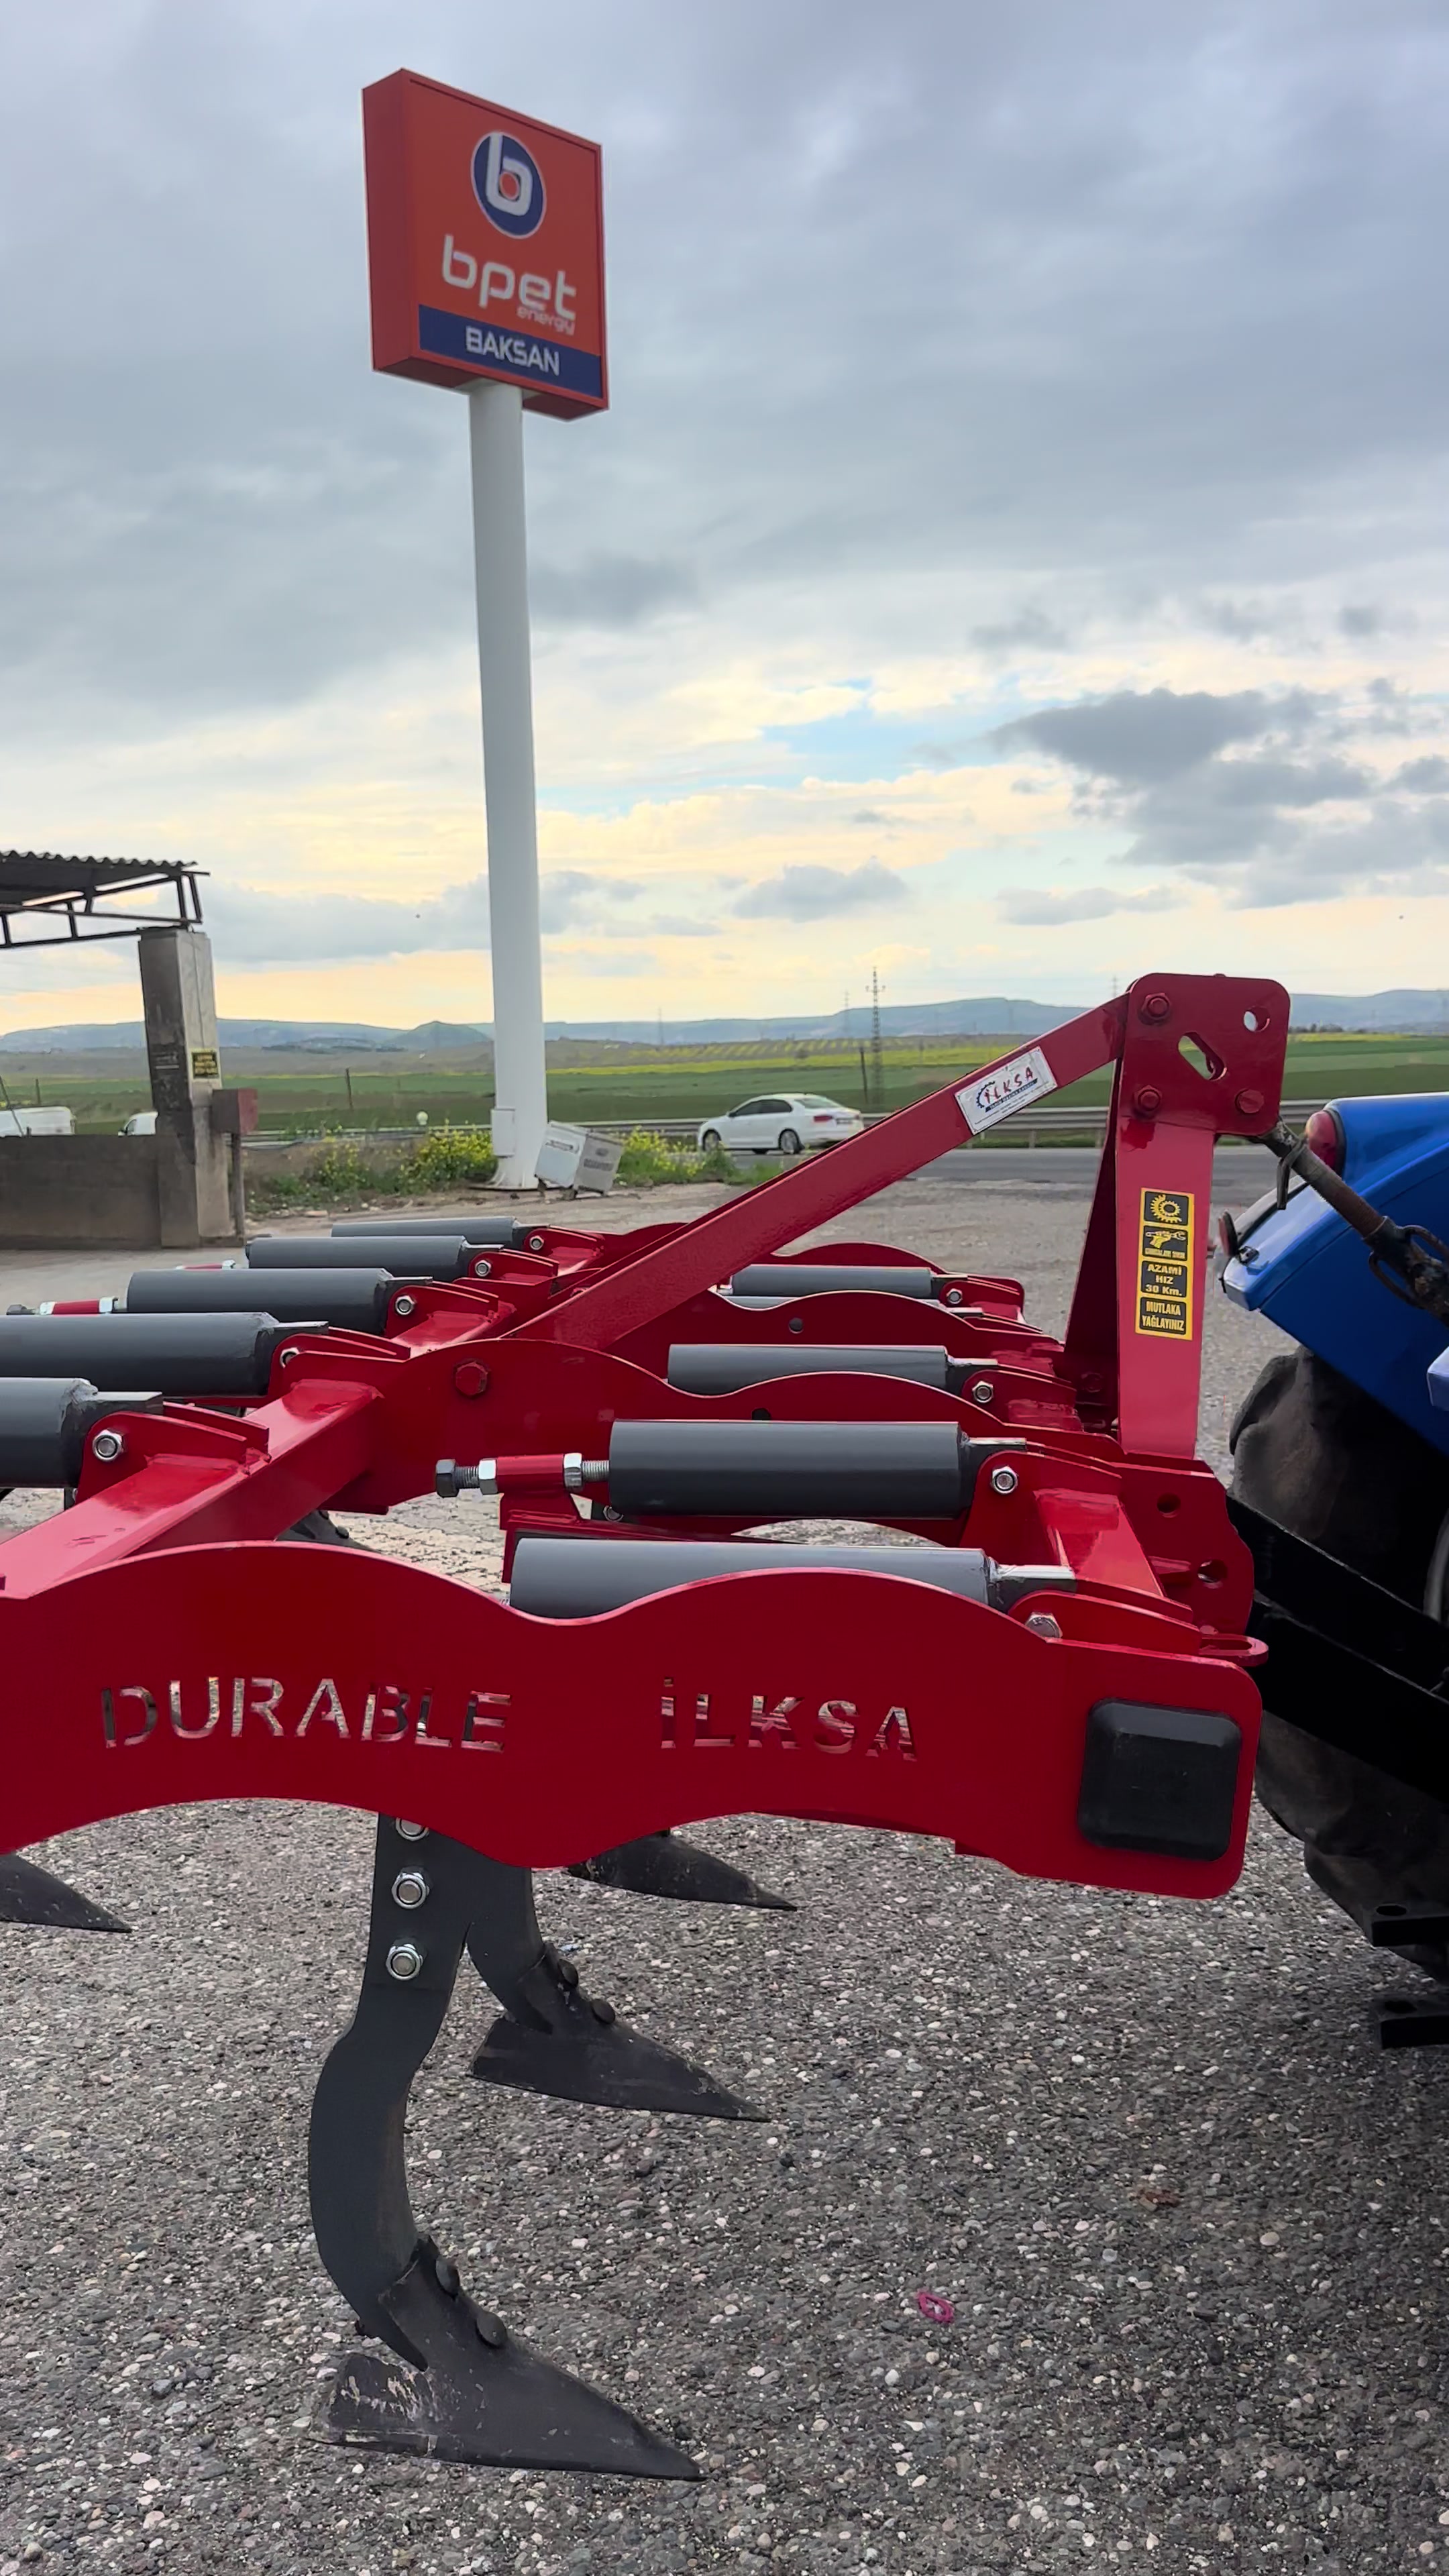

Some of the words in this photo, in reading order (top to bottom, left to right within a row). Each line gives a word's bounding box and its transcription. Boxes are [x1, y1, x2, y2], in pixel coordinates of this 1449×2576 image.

[441, 234, 576, 319] bpet
[517, 306, 576, 335] energy
[466, 326, 560, 376] BAKSAN
[1146, 1263, 1182, 1275] AZAMİ
[1155, 1275, 1173, 1285] HIZ
[1145, 1285, 1159, 1293] 30
[1162, 1286, 1183, 1297] Km.
[1146, 1301, 1181, 1316] MUTLAKA
[1142, 1315, 1185, 1332] YAĞLAYINIZ
[101, 1676, 513, 1754] DURABLE
[659, 1676, 918, 1762] İLKSA
